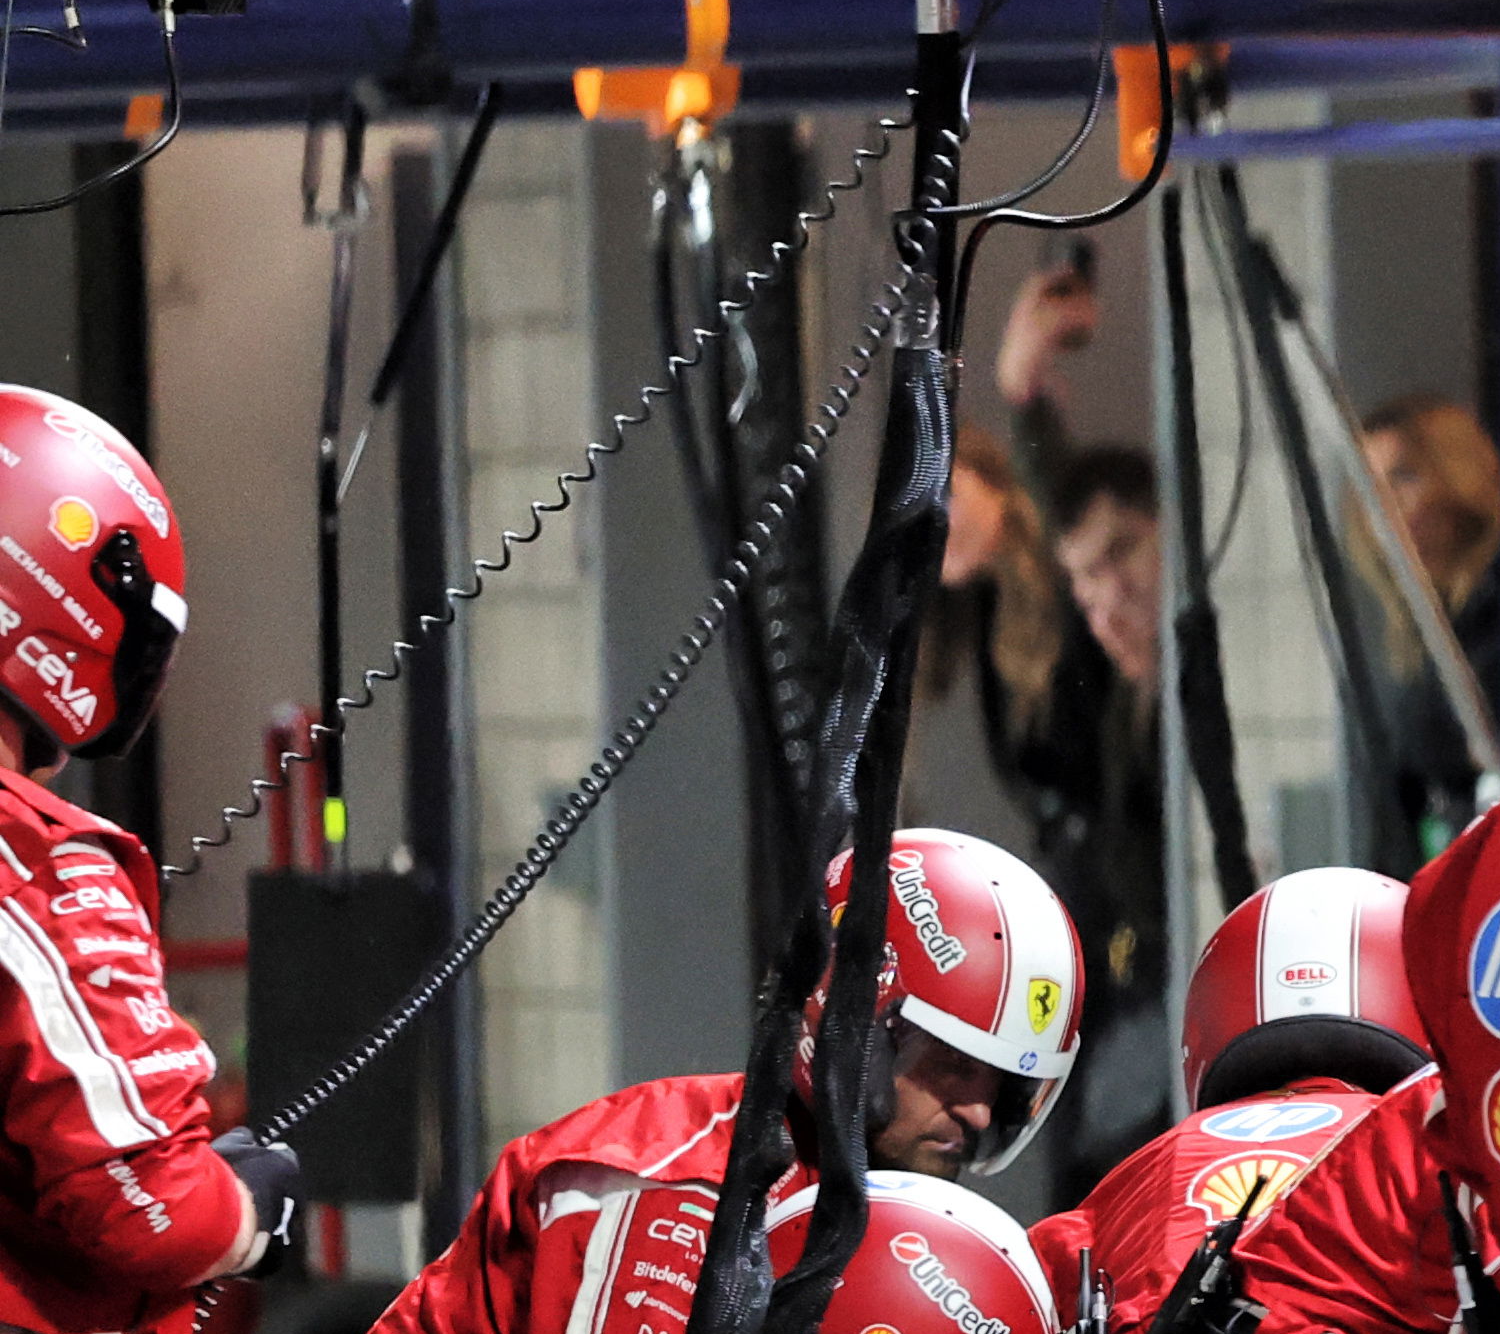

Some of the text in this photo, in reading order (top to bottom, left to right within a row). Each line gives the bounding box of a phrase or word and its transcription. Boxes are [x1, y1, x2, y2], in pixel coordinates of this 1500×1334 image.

[62, 594, 105, 641] MILLE
[892, 867, 965, 972] UniCredit
[1285, 966, 1331, 983] BELL
[1211, 1103, 1320, 1142] hp
